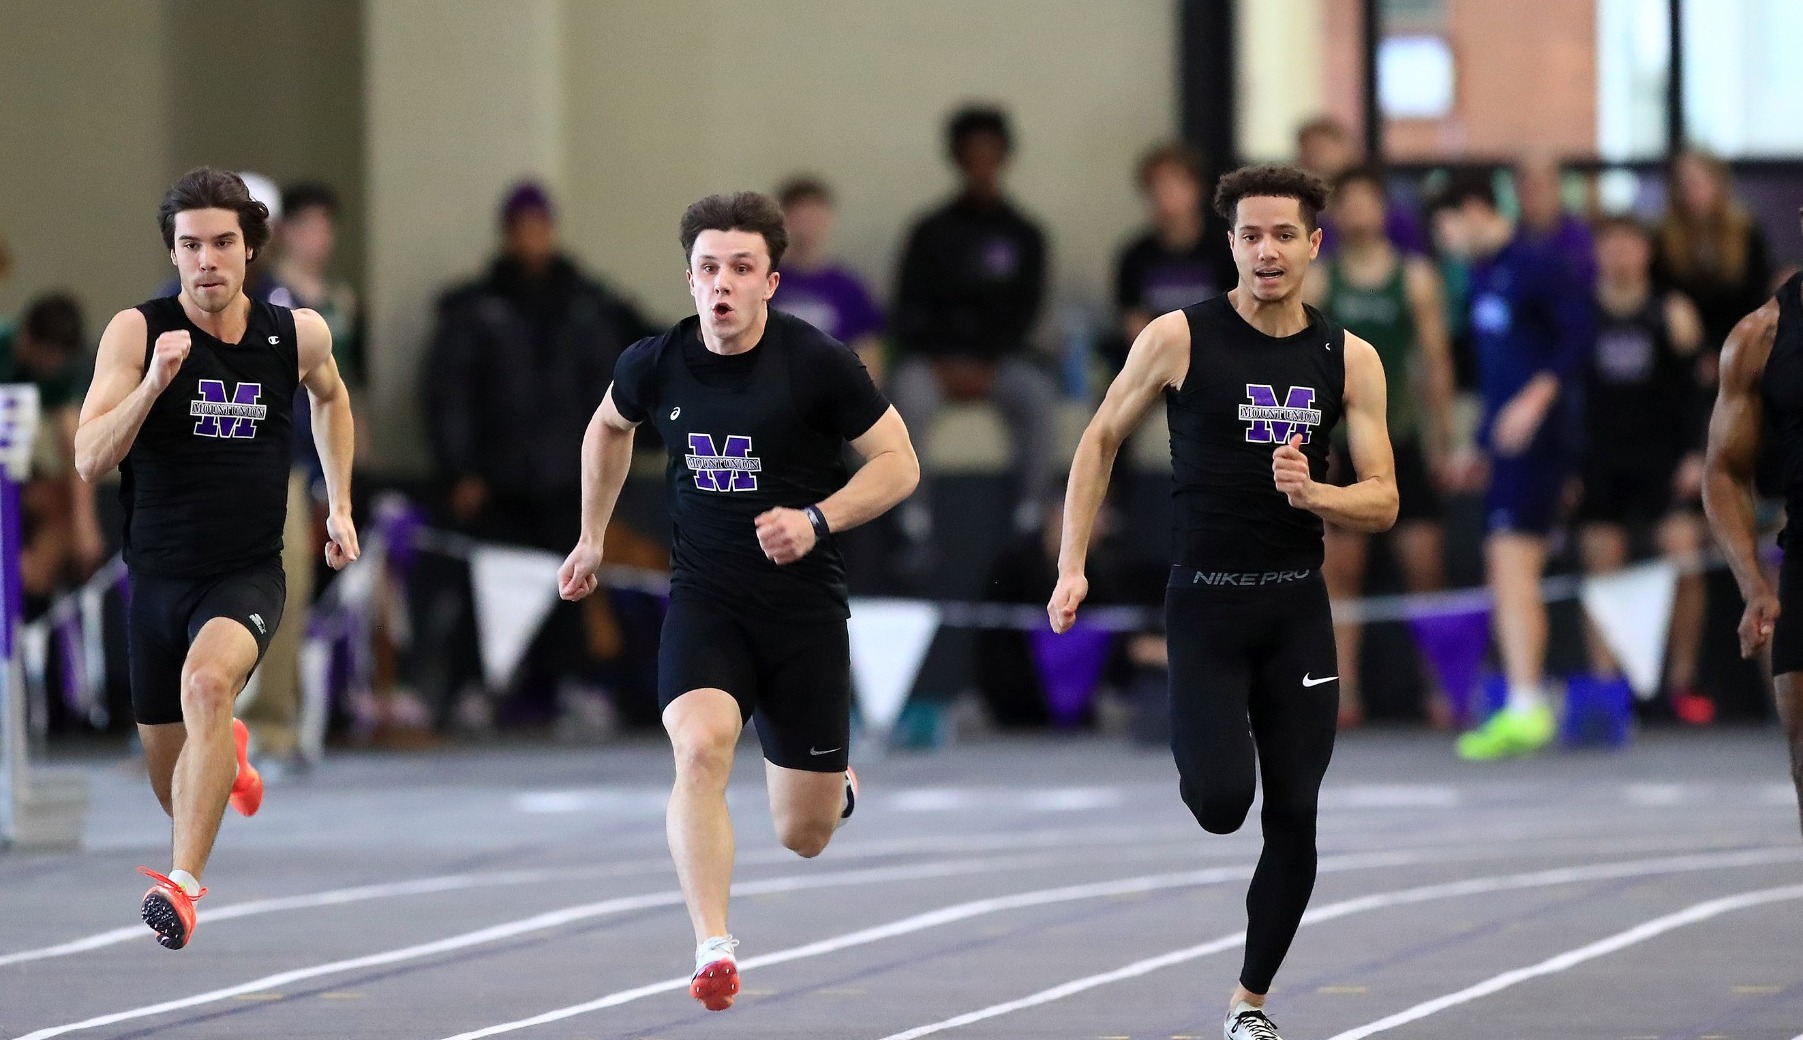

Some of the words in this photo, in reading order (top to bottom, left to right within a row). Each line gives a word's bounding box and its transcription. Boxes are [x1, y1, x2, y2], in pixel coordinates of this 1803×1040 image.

[193, 379, 262, 439] M
[1245, 383, 1316, 445] M
[688, 432, 758, 492] M
[1193, 570, 1259, 586] NIKE
